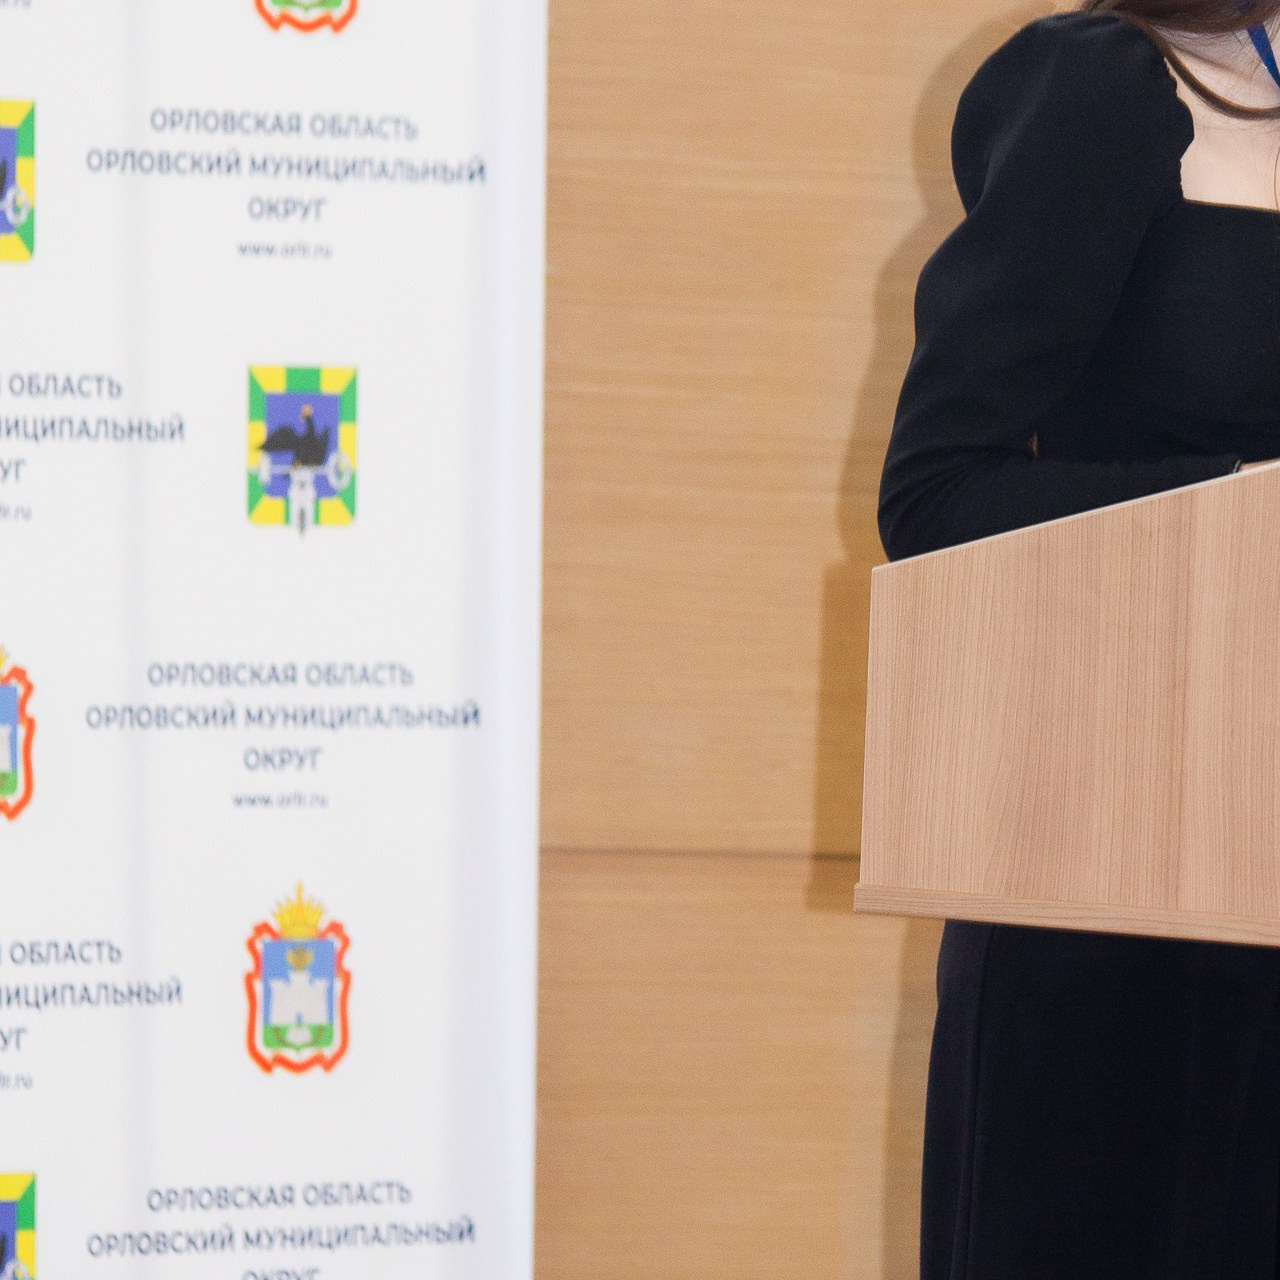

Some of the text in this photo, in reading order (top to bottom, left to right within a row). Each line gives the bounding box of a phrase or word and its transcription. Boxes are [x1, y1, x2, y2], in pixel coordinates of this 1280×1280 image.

[150, 108, 418, 140] ОРЛОВСКАЯ ОБЛАСТЬ
[86, 148, 487, 185] ОРЛОВСКИЙ МУНИЦИПАЛЬНЫЙ
[248, 196, 325, 220] ОКРУГ
[8, 373, 123, 398] ОБЛАСТЬ
[147, 662, 414, 686] ОРЛОВСКАЯ ОБЛАСТЬ
[85, 699, 482, 731] ОРЛОВСКИЙ МУНИЦИПАЛЬНЫЙ
[243, 747, 321, 771] ОКРУГ
[9, 940, 122, 965] ОБЛАСТЬ
[146, 1180, 412, 1213] ОРЛОВСКАЯ ОБЛАСТЬ
[86, 1214, 476, 1258] ОРЛОВСКИЙ МУНИЦИПАЛЬНЫЙ
